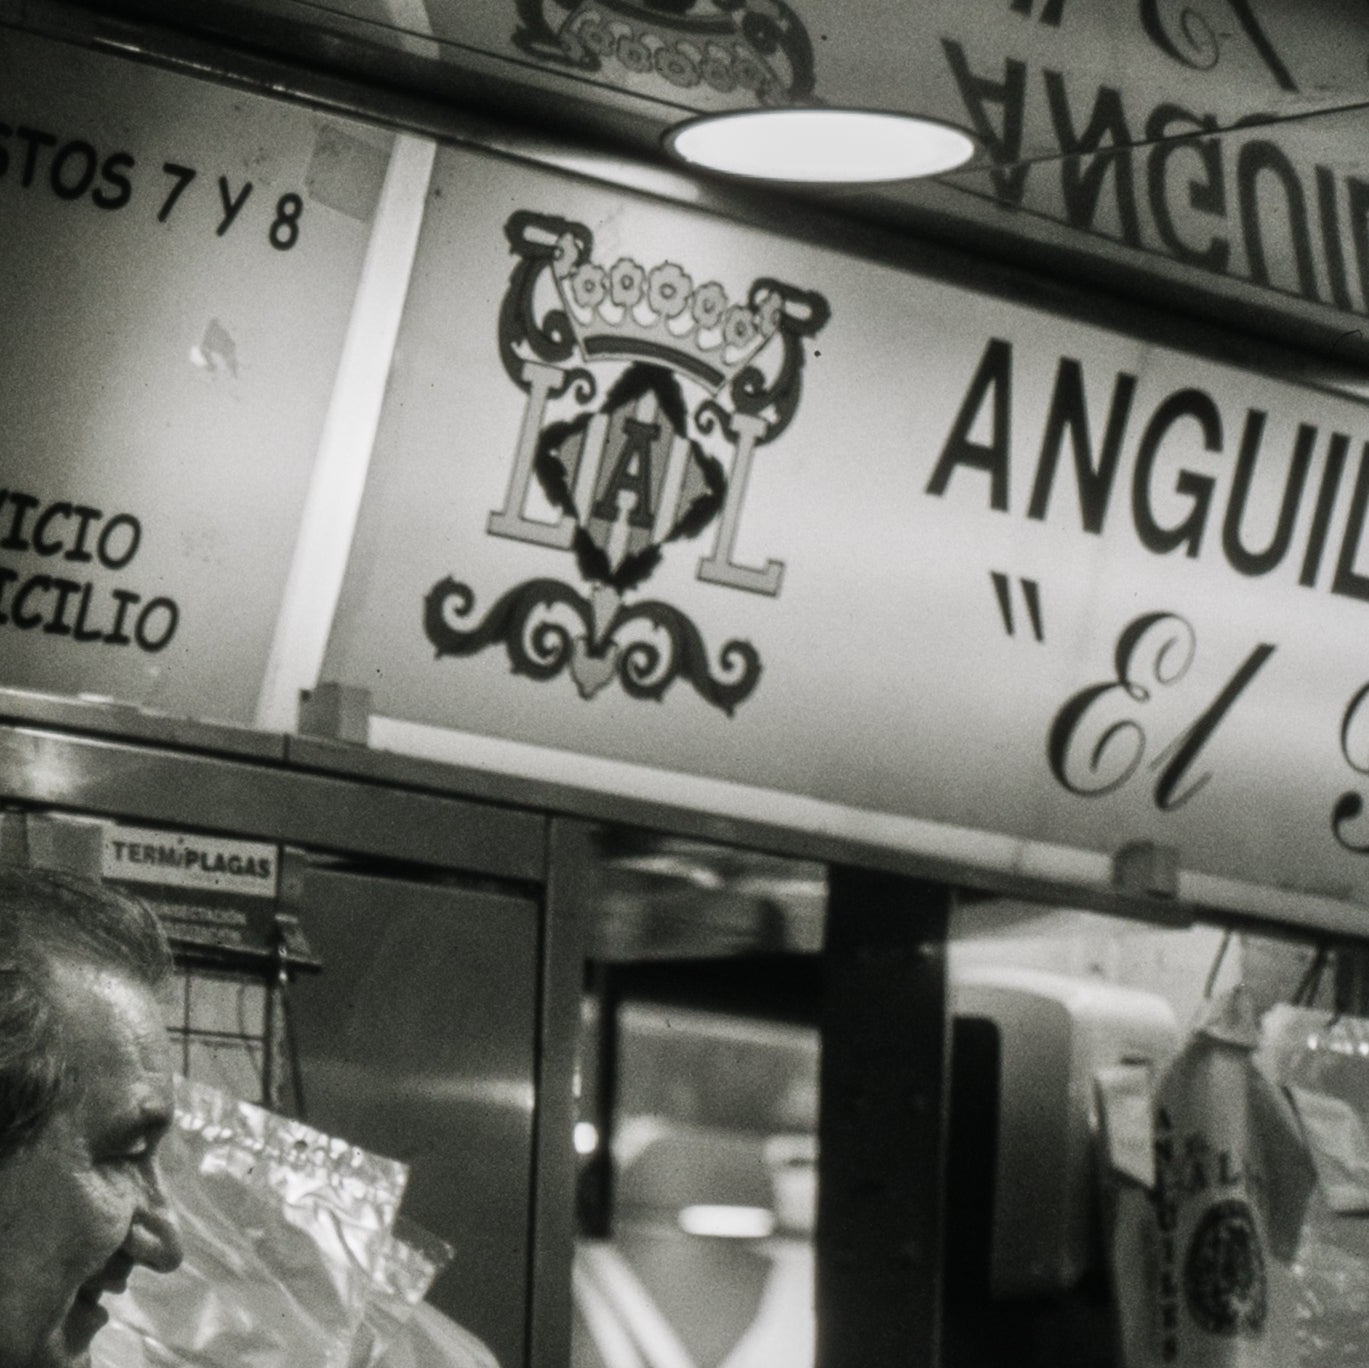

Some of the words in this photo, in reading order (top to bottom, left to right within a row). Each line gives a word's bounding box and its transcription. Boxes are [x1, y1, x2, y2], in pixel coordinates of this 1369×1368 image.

[155, 162, 196, 223] 7
[215, 175, 253, 237] Y
[268, 192, 304, 251] 8
